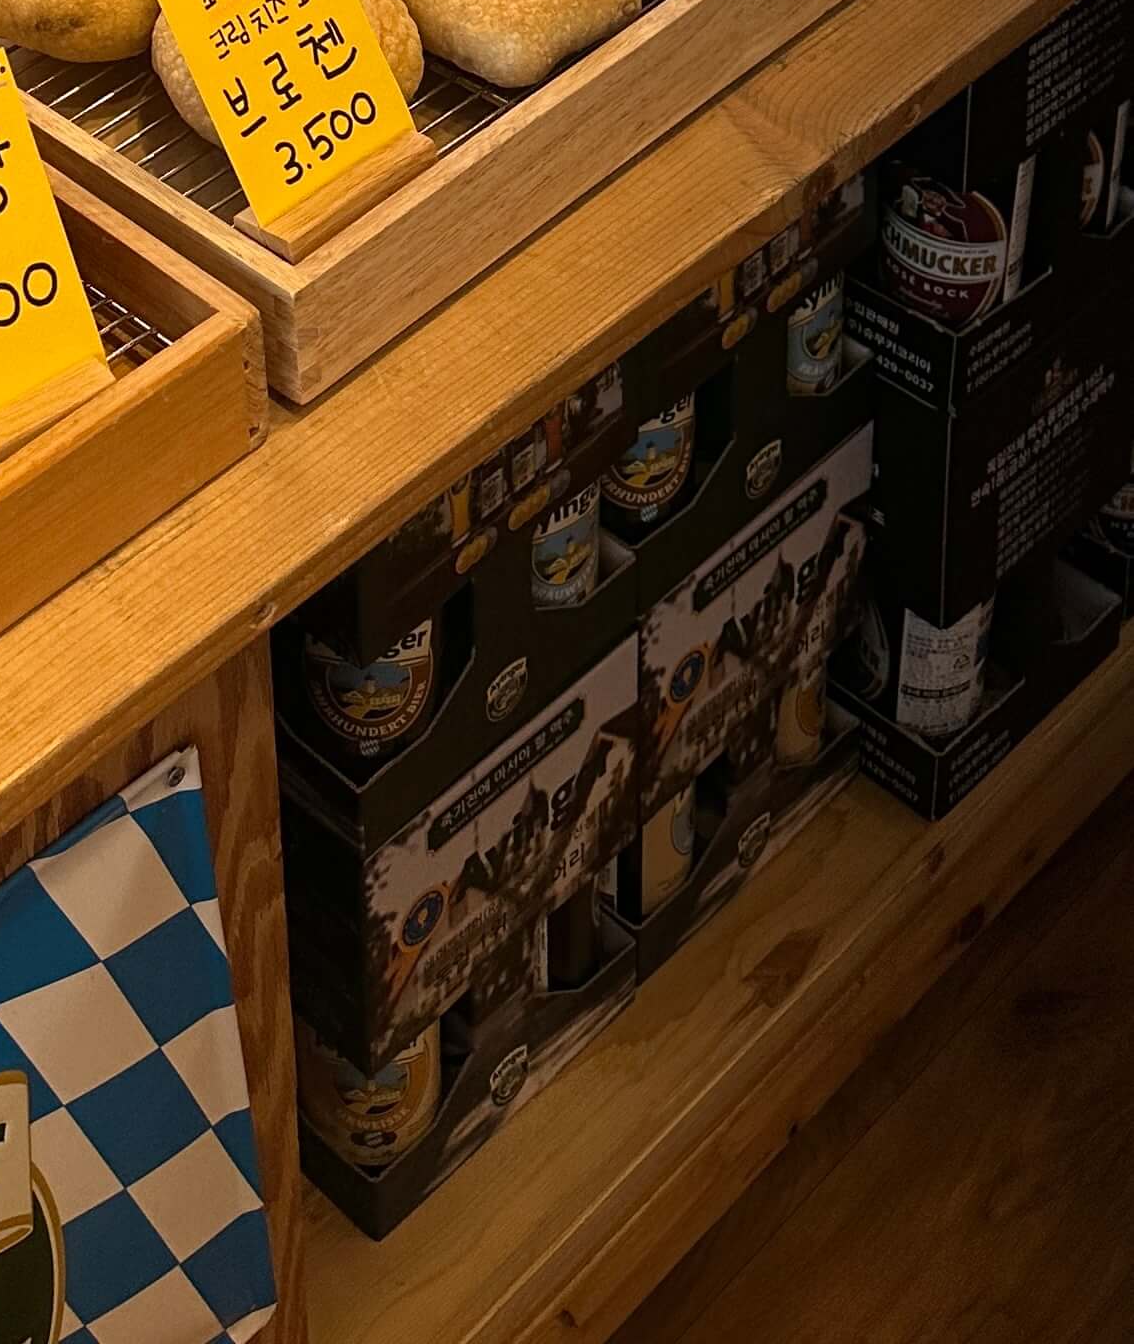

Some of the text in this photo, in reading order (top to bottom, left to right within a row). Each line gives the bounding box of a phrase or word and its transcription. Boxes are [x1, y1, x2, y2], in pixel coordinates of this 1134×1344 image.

[223, 16, 358, 138] 브로첸
[275, 92, 377, 186] 3.500
[884, 224, 997, 275] CHMUCKER
